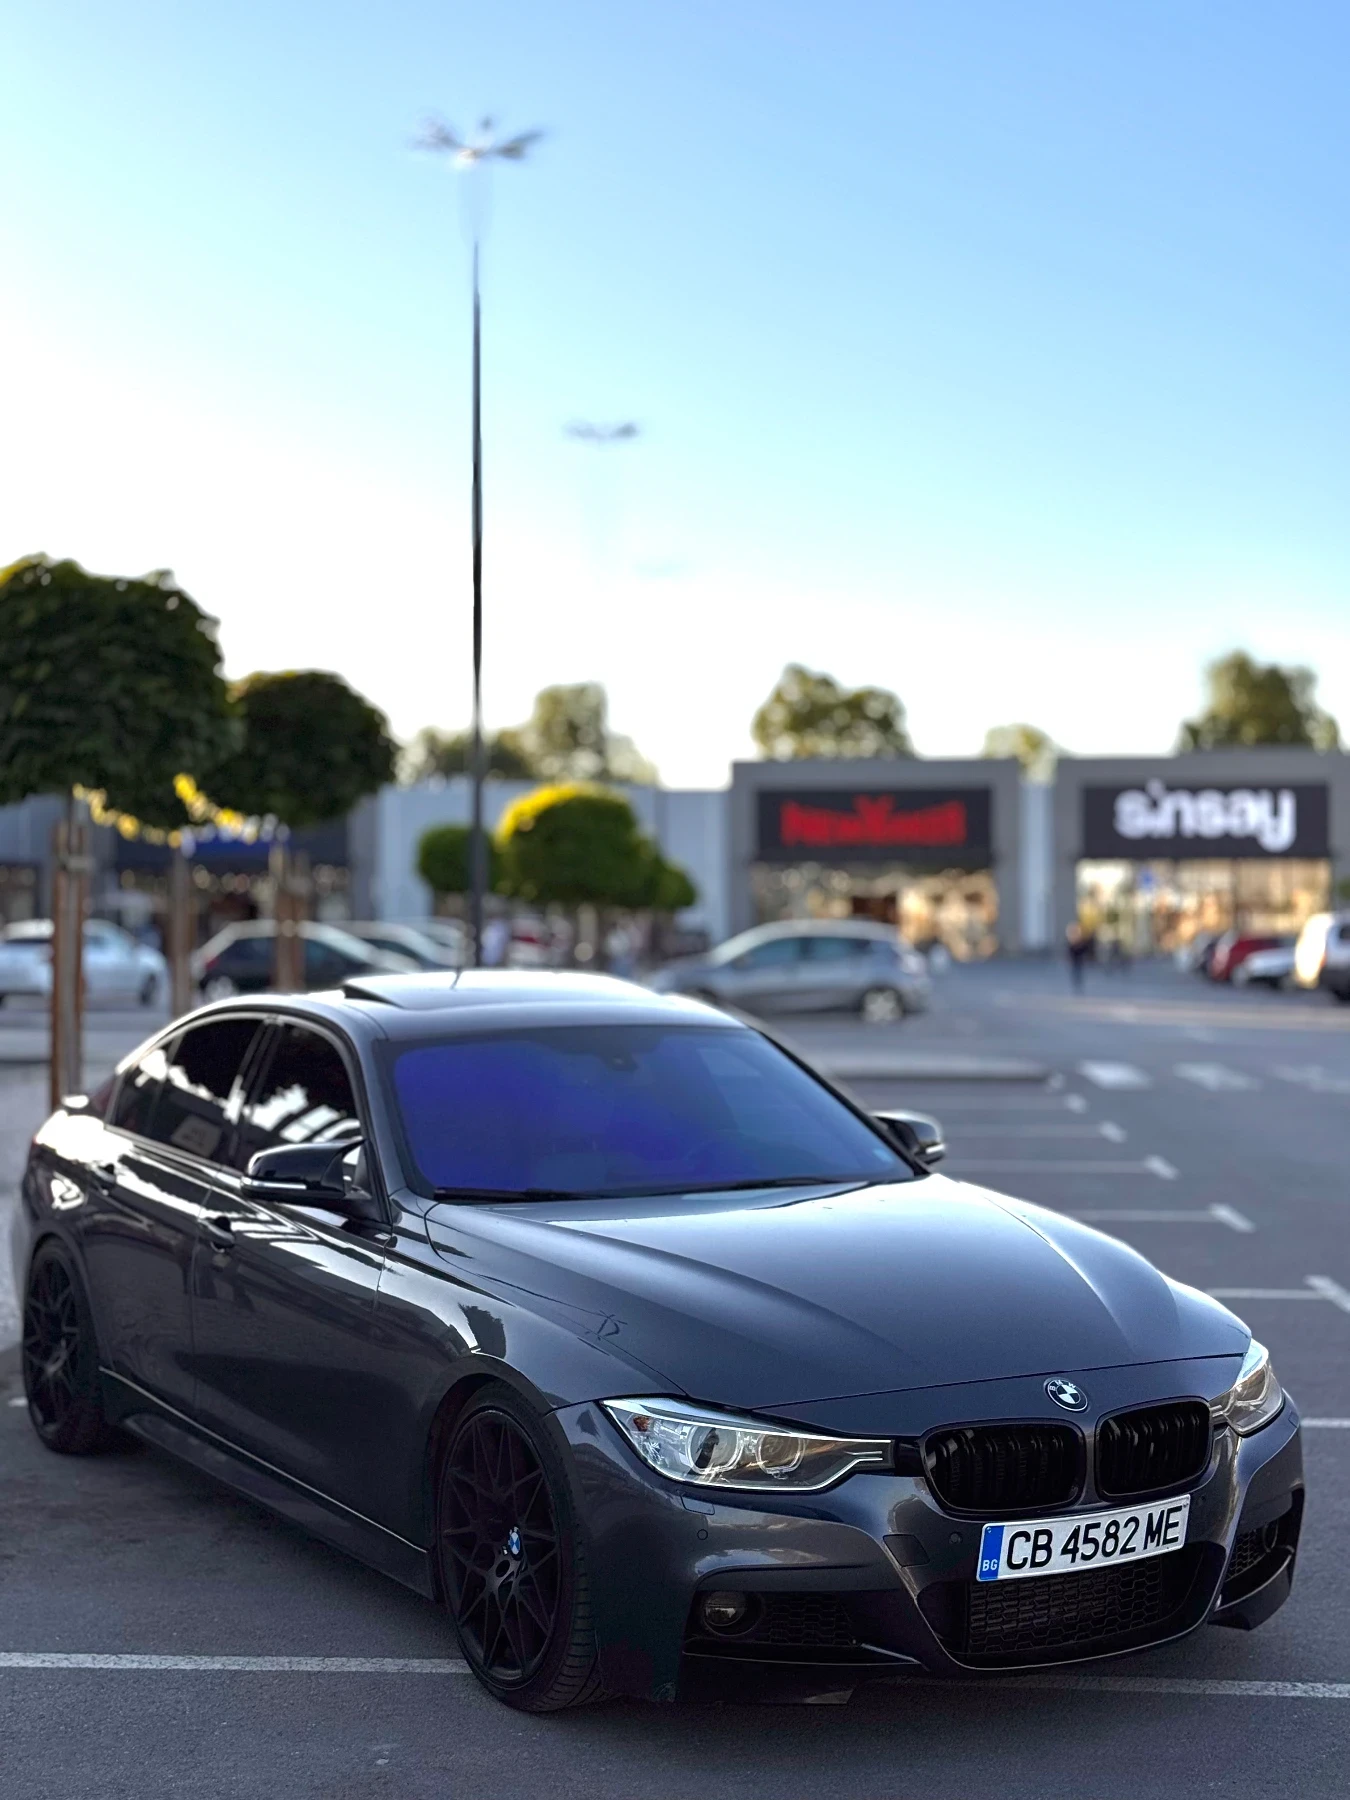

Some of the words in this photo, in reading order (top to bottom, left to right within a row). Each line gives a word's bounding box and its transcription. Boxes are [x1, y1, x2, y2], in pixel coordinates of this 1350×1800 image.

[1006, 1528, 1053, 1570] CB
[1060, 1515, 1140, 1563] 4582
[1143, 1505, 1183, 1550] ME
[982, 1558, 998, 1571] BG
